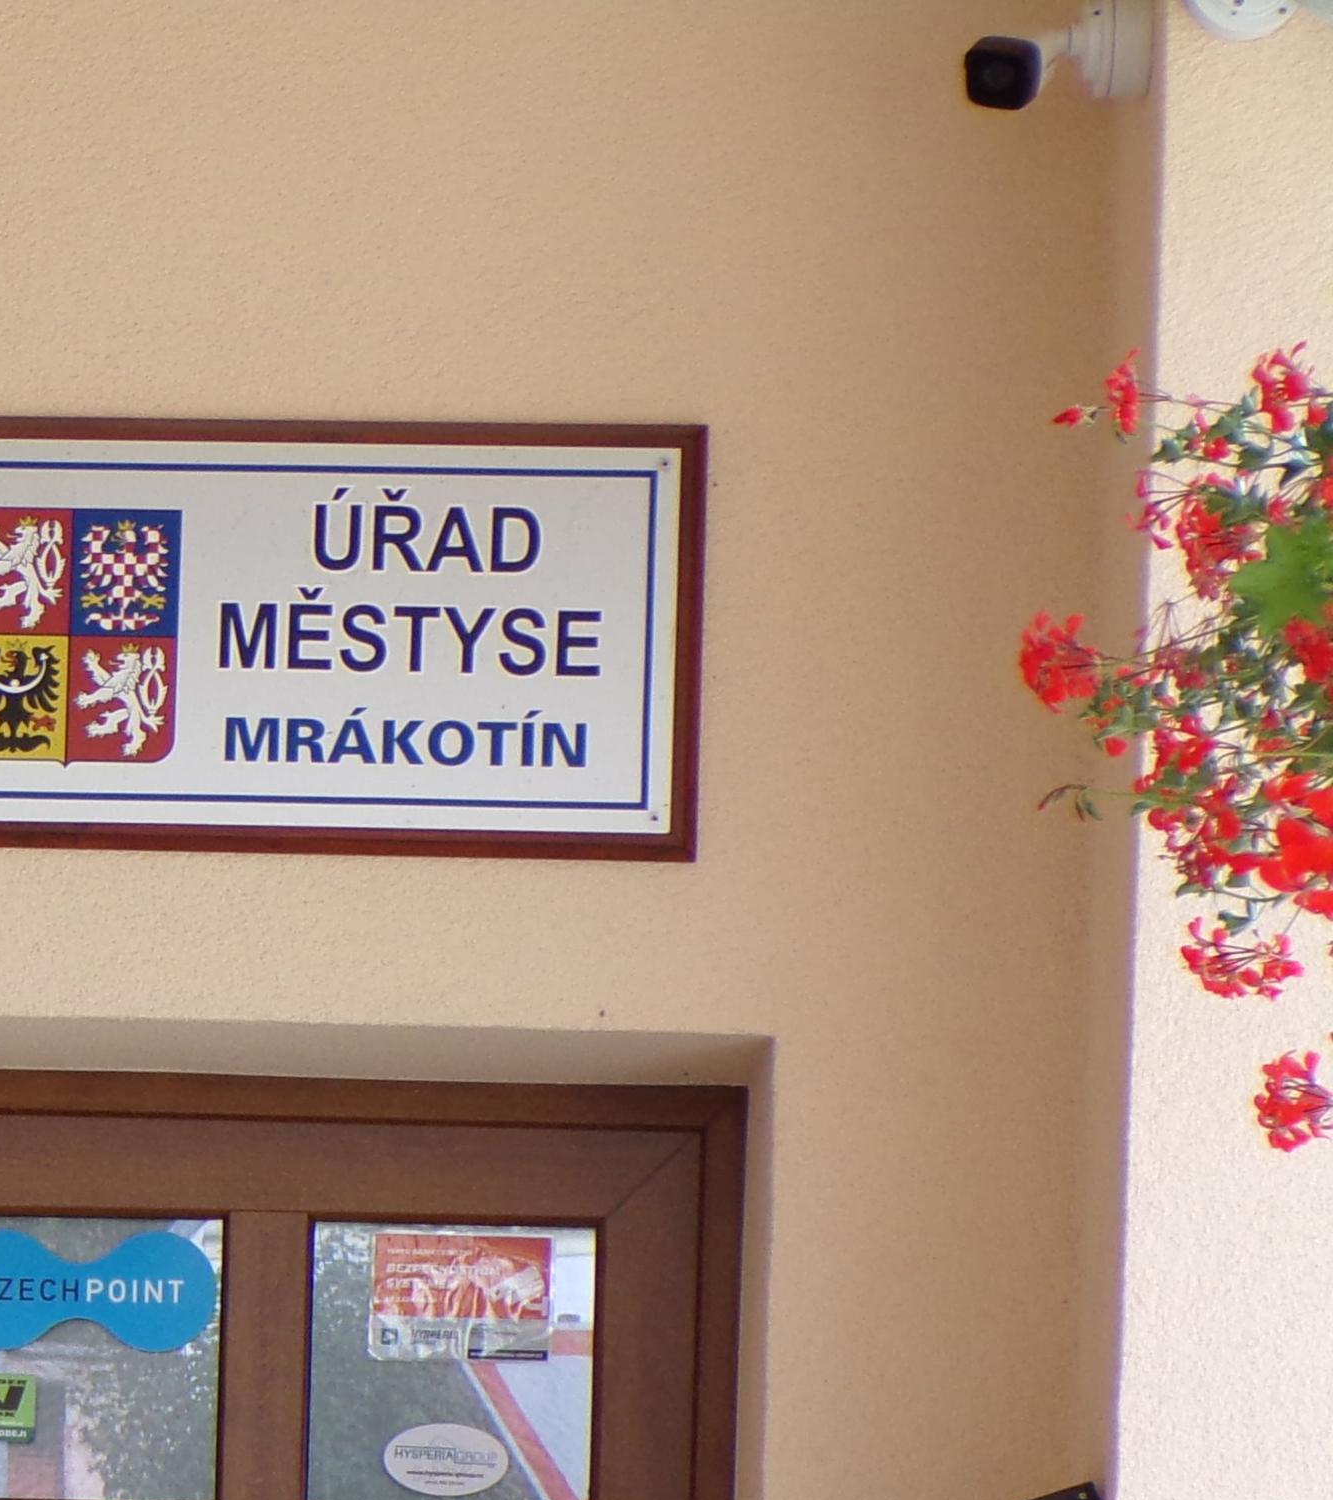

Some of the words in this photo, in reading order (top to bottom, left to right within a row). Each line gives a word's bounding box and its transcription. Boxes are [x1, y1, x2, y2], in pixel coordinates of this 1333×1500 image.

[312, 486, 544, 575] ÚŘAD
[217, 586, 604, 679] MĚSTYSE
[222, 707, 589, 770] MRÁKOTÍN
